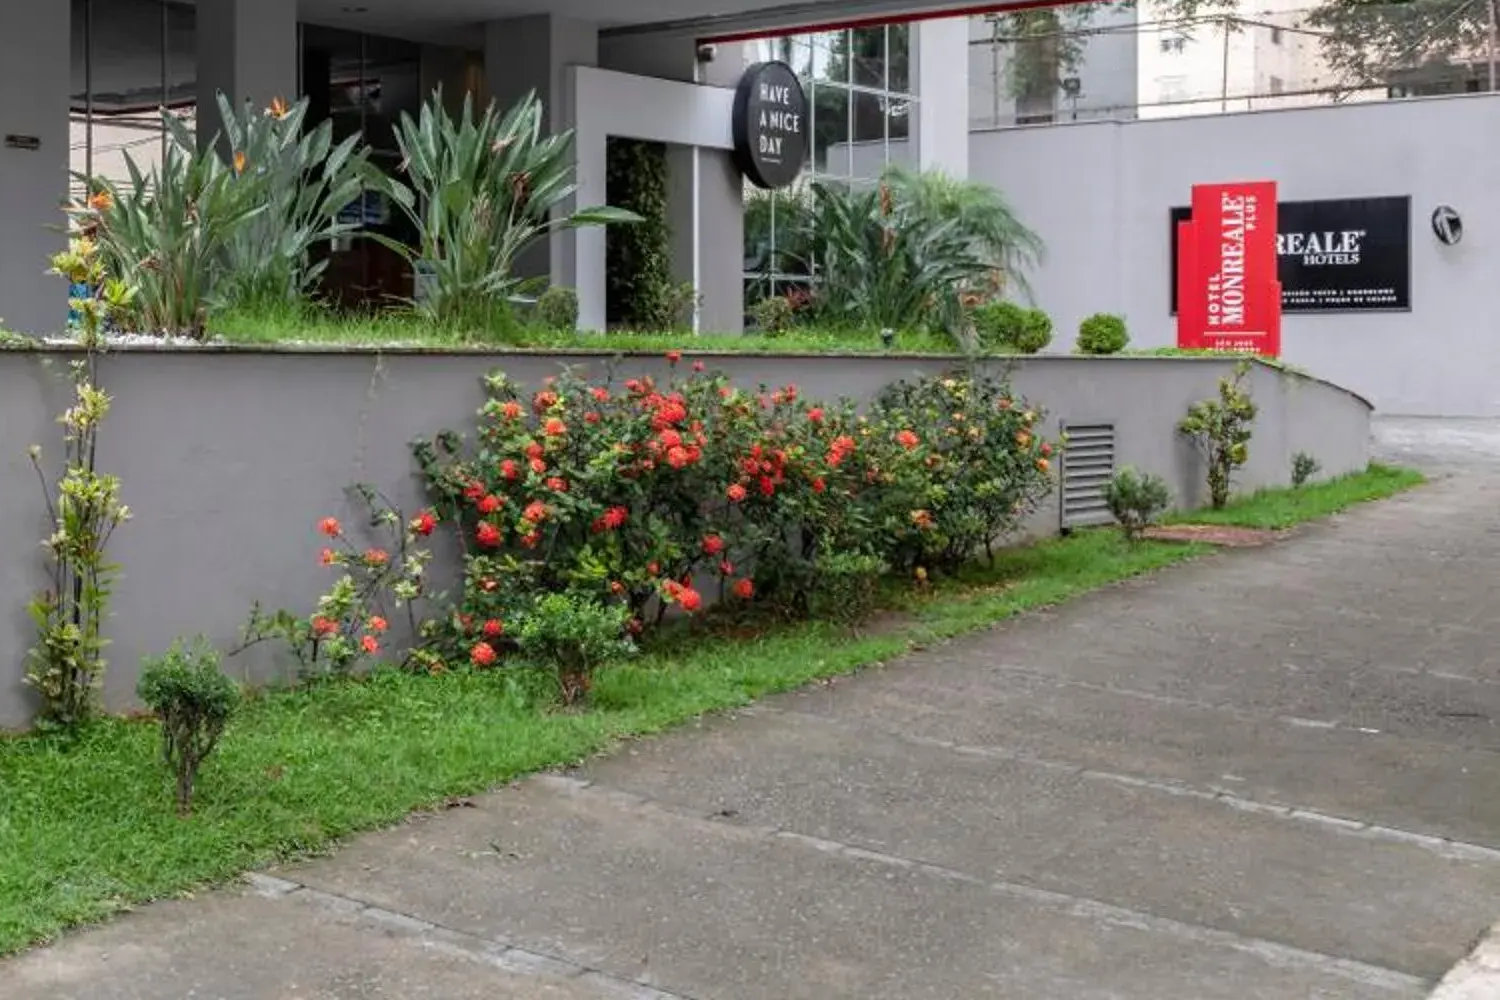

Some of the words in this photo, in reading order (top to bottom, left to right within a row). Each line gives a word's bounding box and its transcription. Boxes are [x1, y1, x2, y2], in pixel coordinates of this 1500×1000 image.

[759, 82, 790, 105] HAVE
[759, 109, 767, 127] A
[769, 111, 800, 133] NICE
[759, 134, 782, 155] DAY
[1245, 195, 1257, 231] PLUS
[1221, 193, 1245, 325] MONREALE
[1303, 253, 1361, 265] HOTELS
[1208, 272, 1221, 325] HOTEL
